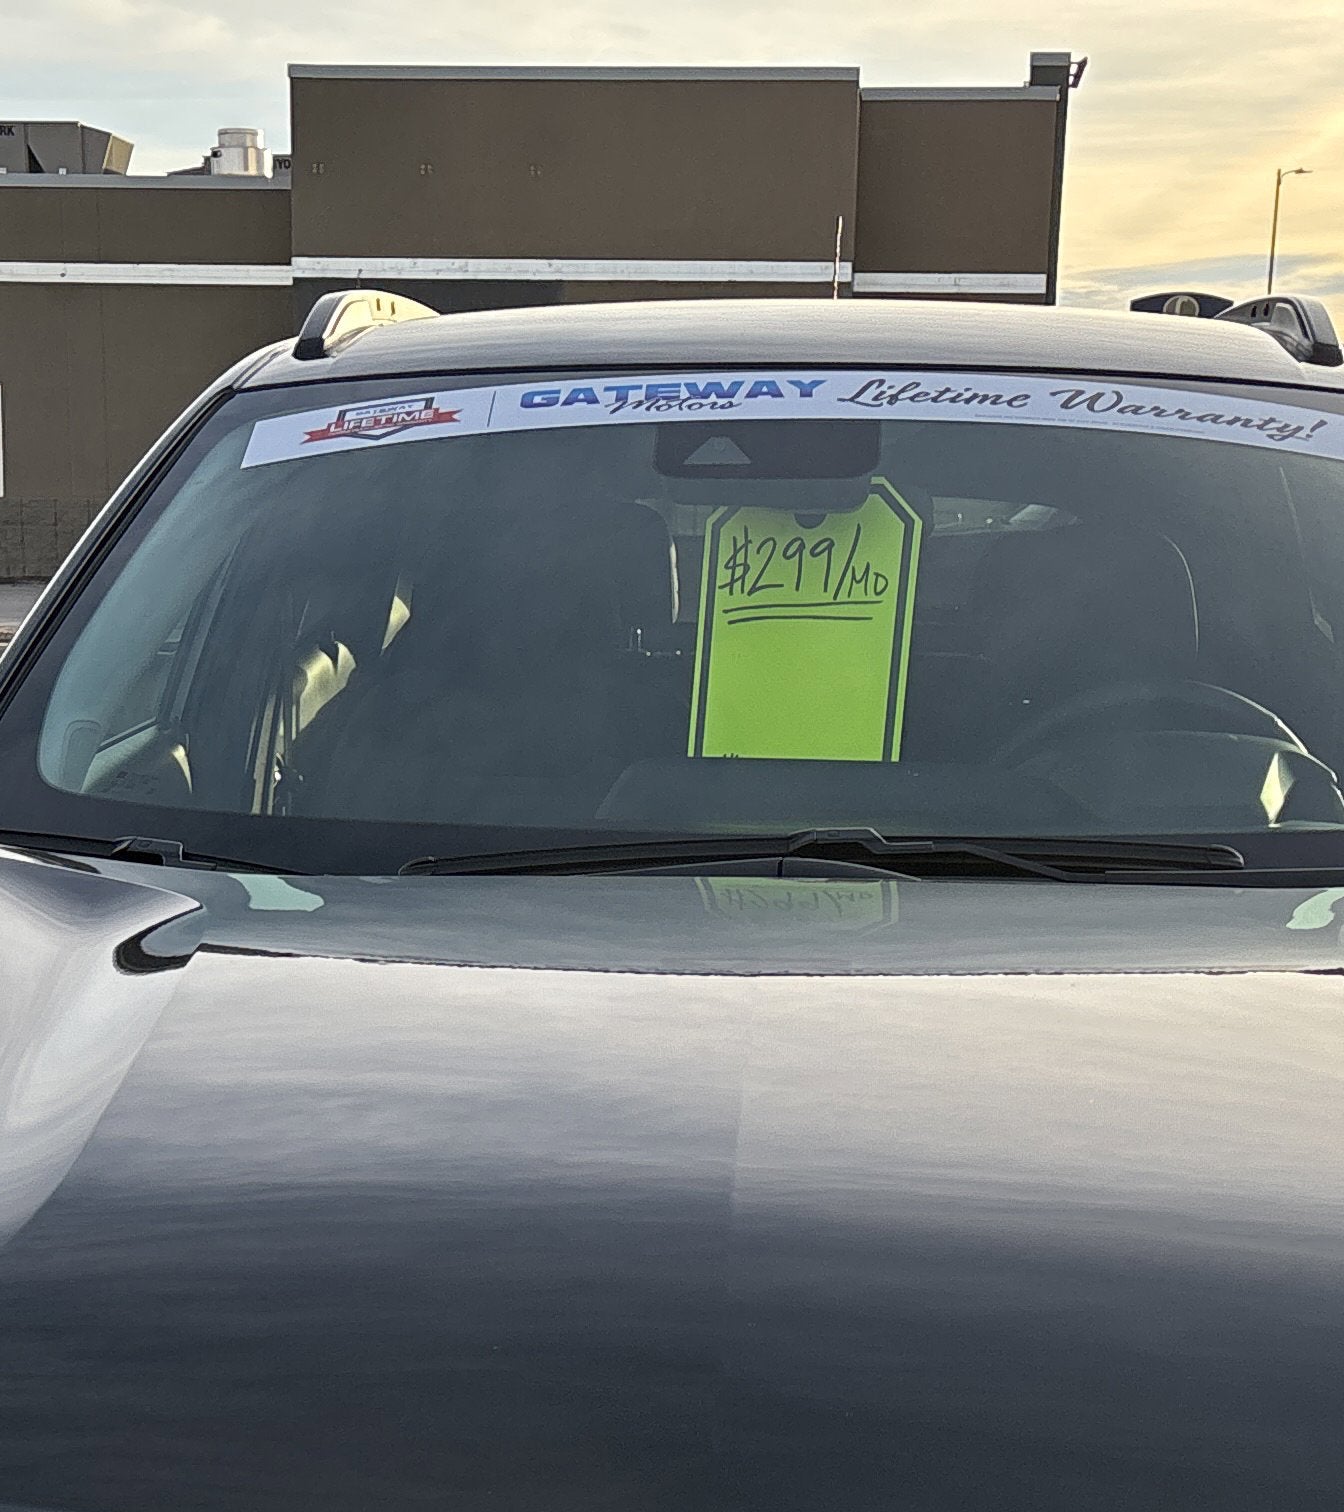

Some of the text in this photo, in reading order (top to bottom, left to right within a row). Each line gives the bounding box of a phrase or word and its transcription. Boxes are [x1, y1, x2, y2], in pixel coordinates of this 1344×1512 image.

[520, 379, 827, 409] GATEWAY
[604, 395, 742, 415] Motors
[329, 408, 435, 433] LIFETIME
[837, 378, 1031, 408] Lifetime
[1049, 389, 1328, 441] Warranty!
